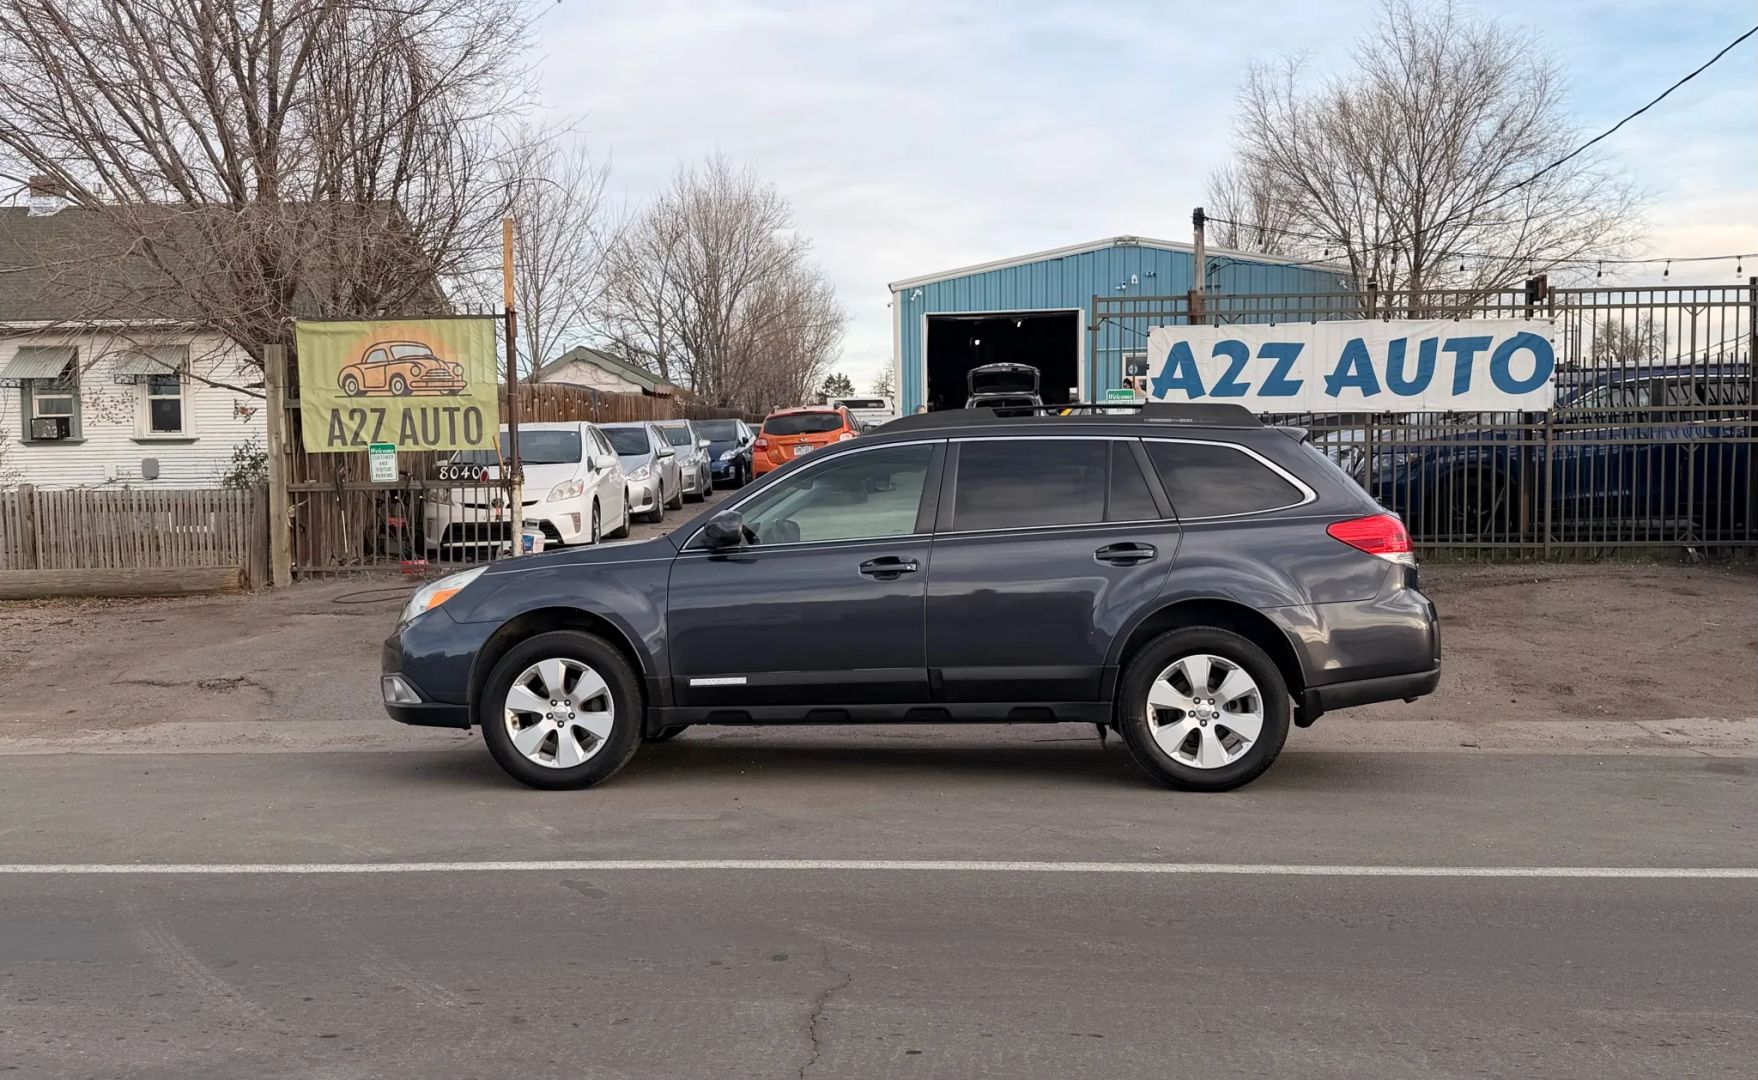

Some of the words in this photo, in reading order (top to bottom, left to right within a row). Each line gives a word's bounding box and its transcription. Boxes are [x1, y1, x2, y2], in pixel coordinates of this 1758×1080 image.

[1151, 339, 1304, 399] A2Z
[1324, 331, 1555, 397] AUTO
[327, 407, 386, 447] A2Z
[399, 406, 483, 446] AUTO
